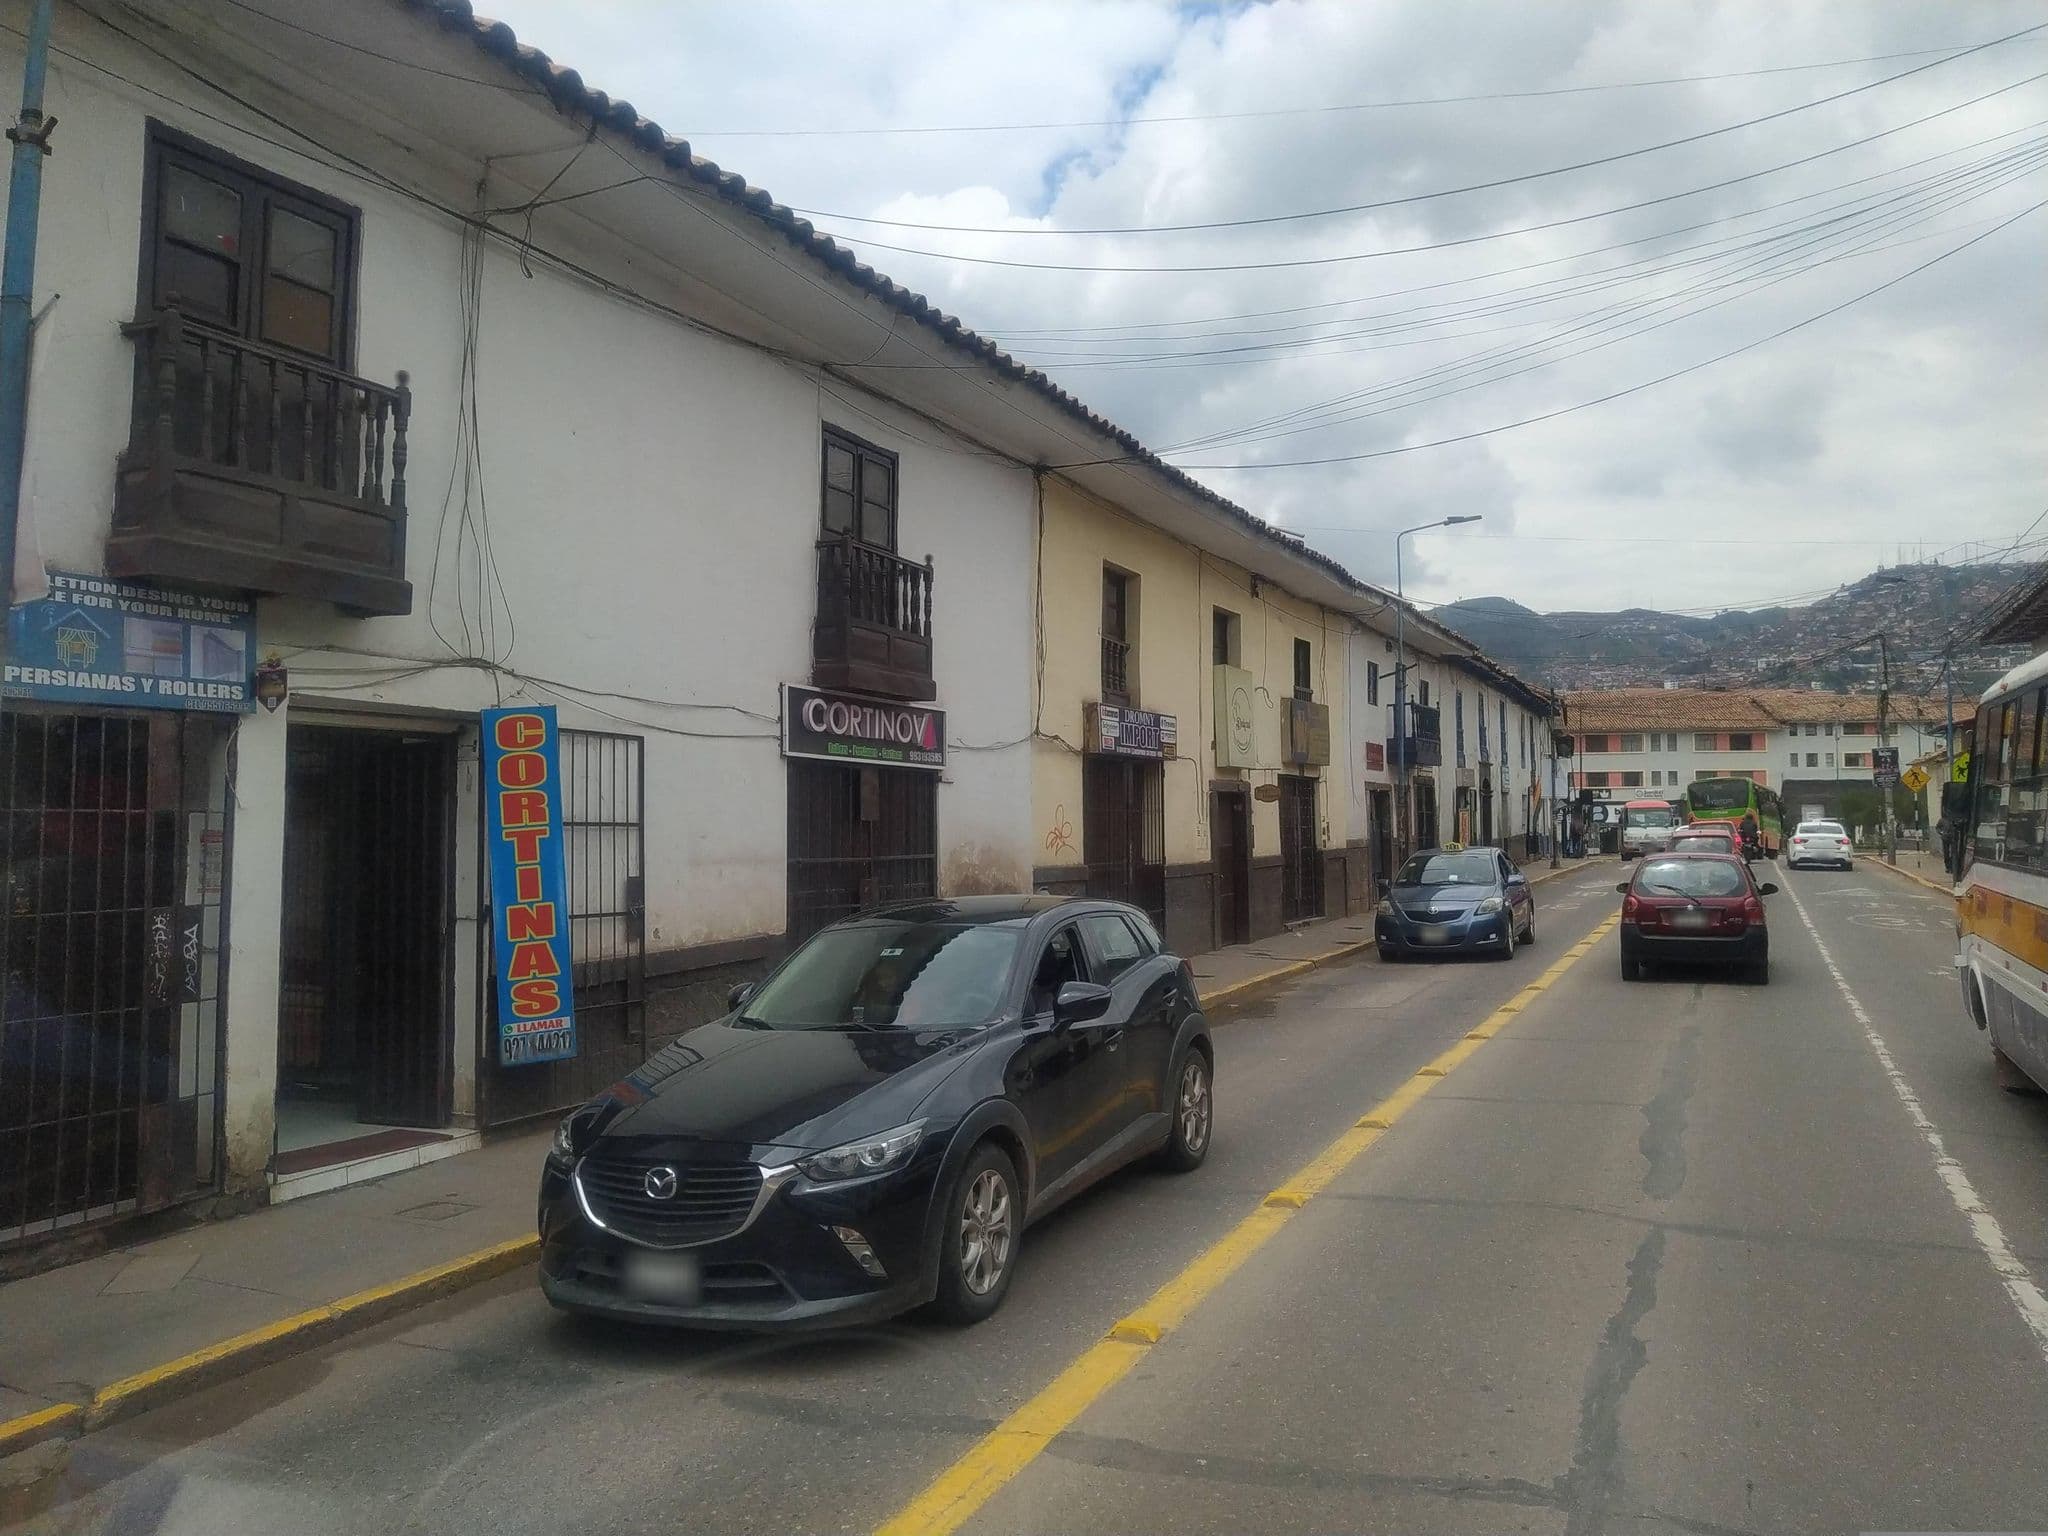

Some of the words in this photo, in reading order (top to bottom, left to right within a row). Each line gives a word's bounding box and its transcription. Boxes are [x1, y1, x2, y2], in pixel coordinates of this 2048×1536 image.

[72, 593, 113, 608] FOR
[119, 599, 172, 617] YOUR
[4, 665, 136, 692] PERSIANAS
[141, 678, 153, 693] Y
[159, 680, 243, 700] ROLLERS
[1120, 722, 1159, 749] IMPORT
[495, 714, 561, 1018] CORTINAS
[517, 1019, 563, 1033] LLAMAR
